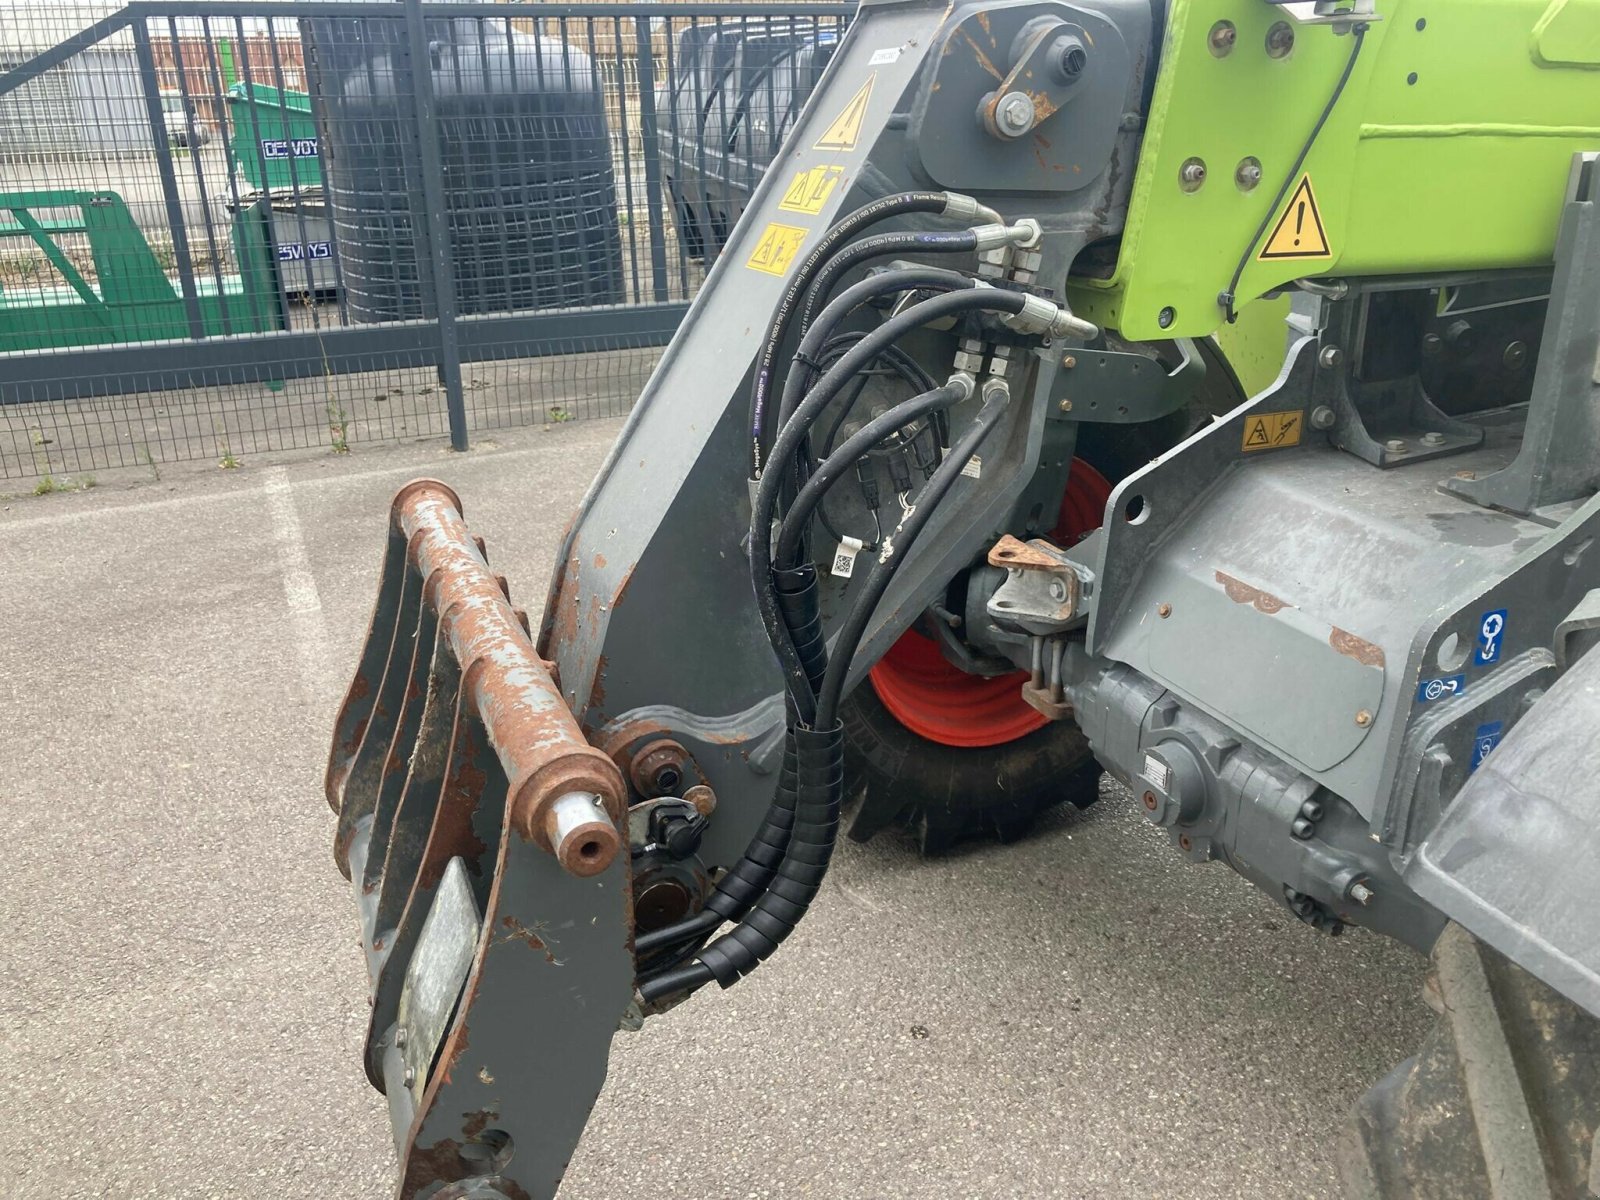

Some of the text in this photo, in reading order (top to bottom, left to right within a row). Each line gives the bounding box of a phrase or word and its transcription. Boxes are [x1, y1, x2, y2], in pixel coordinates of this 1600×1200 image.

[767, 341, 775, 353] MPa
[801, 266, 810, 275] ISO
[807, 251, 821, 266] 11237
[830, 231, 839, 240] SAE
[860, 210, 869, 218] ISO
[886, 199, 898, 207] Type
